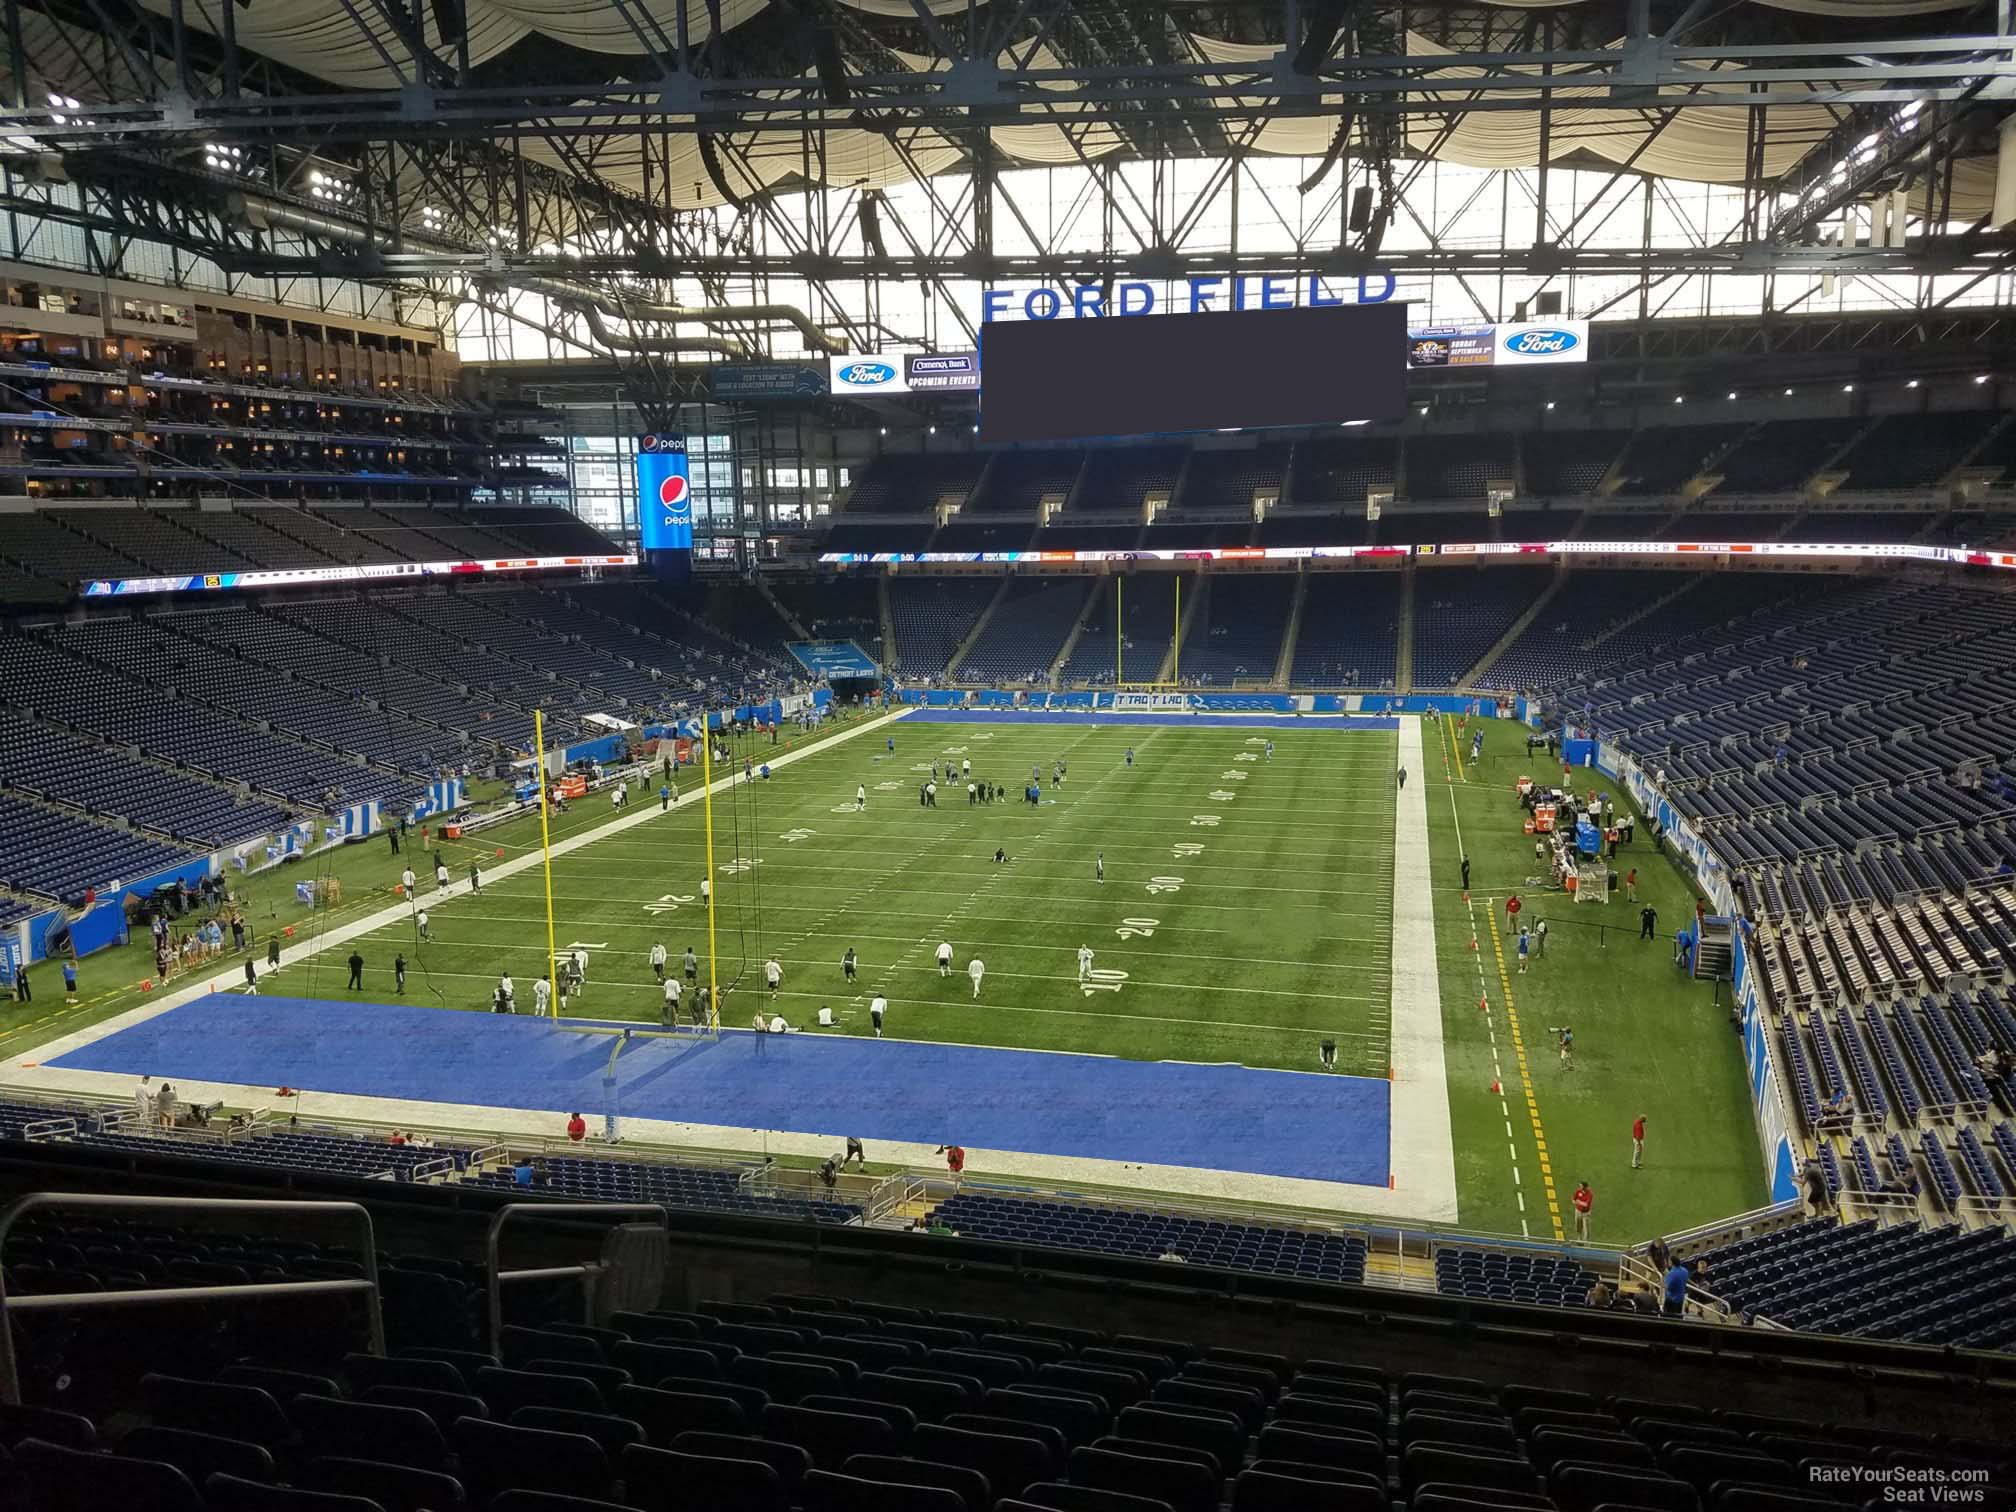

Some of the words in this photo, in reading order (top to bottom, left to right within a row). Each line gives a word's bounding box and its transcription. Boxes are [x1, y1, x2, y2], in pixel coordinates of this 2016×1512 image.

[983, 282, 1156, 323] FORD
[1190, 273, 1397, 315] FIELD
[1518, 331, 1564, 352] Ford
[848, 364, 886, 383] Ford
[908, 376, 948, 387] UPCOMING
[949, 375, 976, 386] EVENTS
[828, 670, 855, 679] DETROIT
[1145, 875, 1185, 892] 30
[642, 894, 696, 911] 20
[1115, 917, 1161, 937] 20
[1079, 969, 1129, 992] 10
